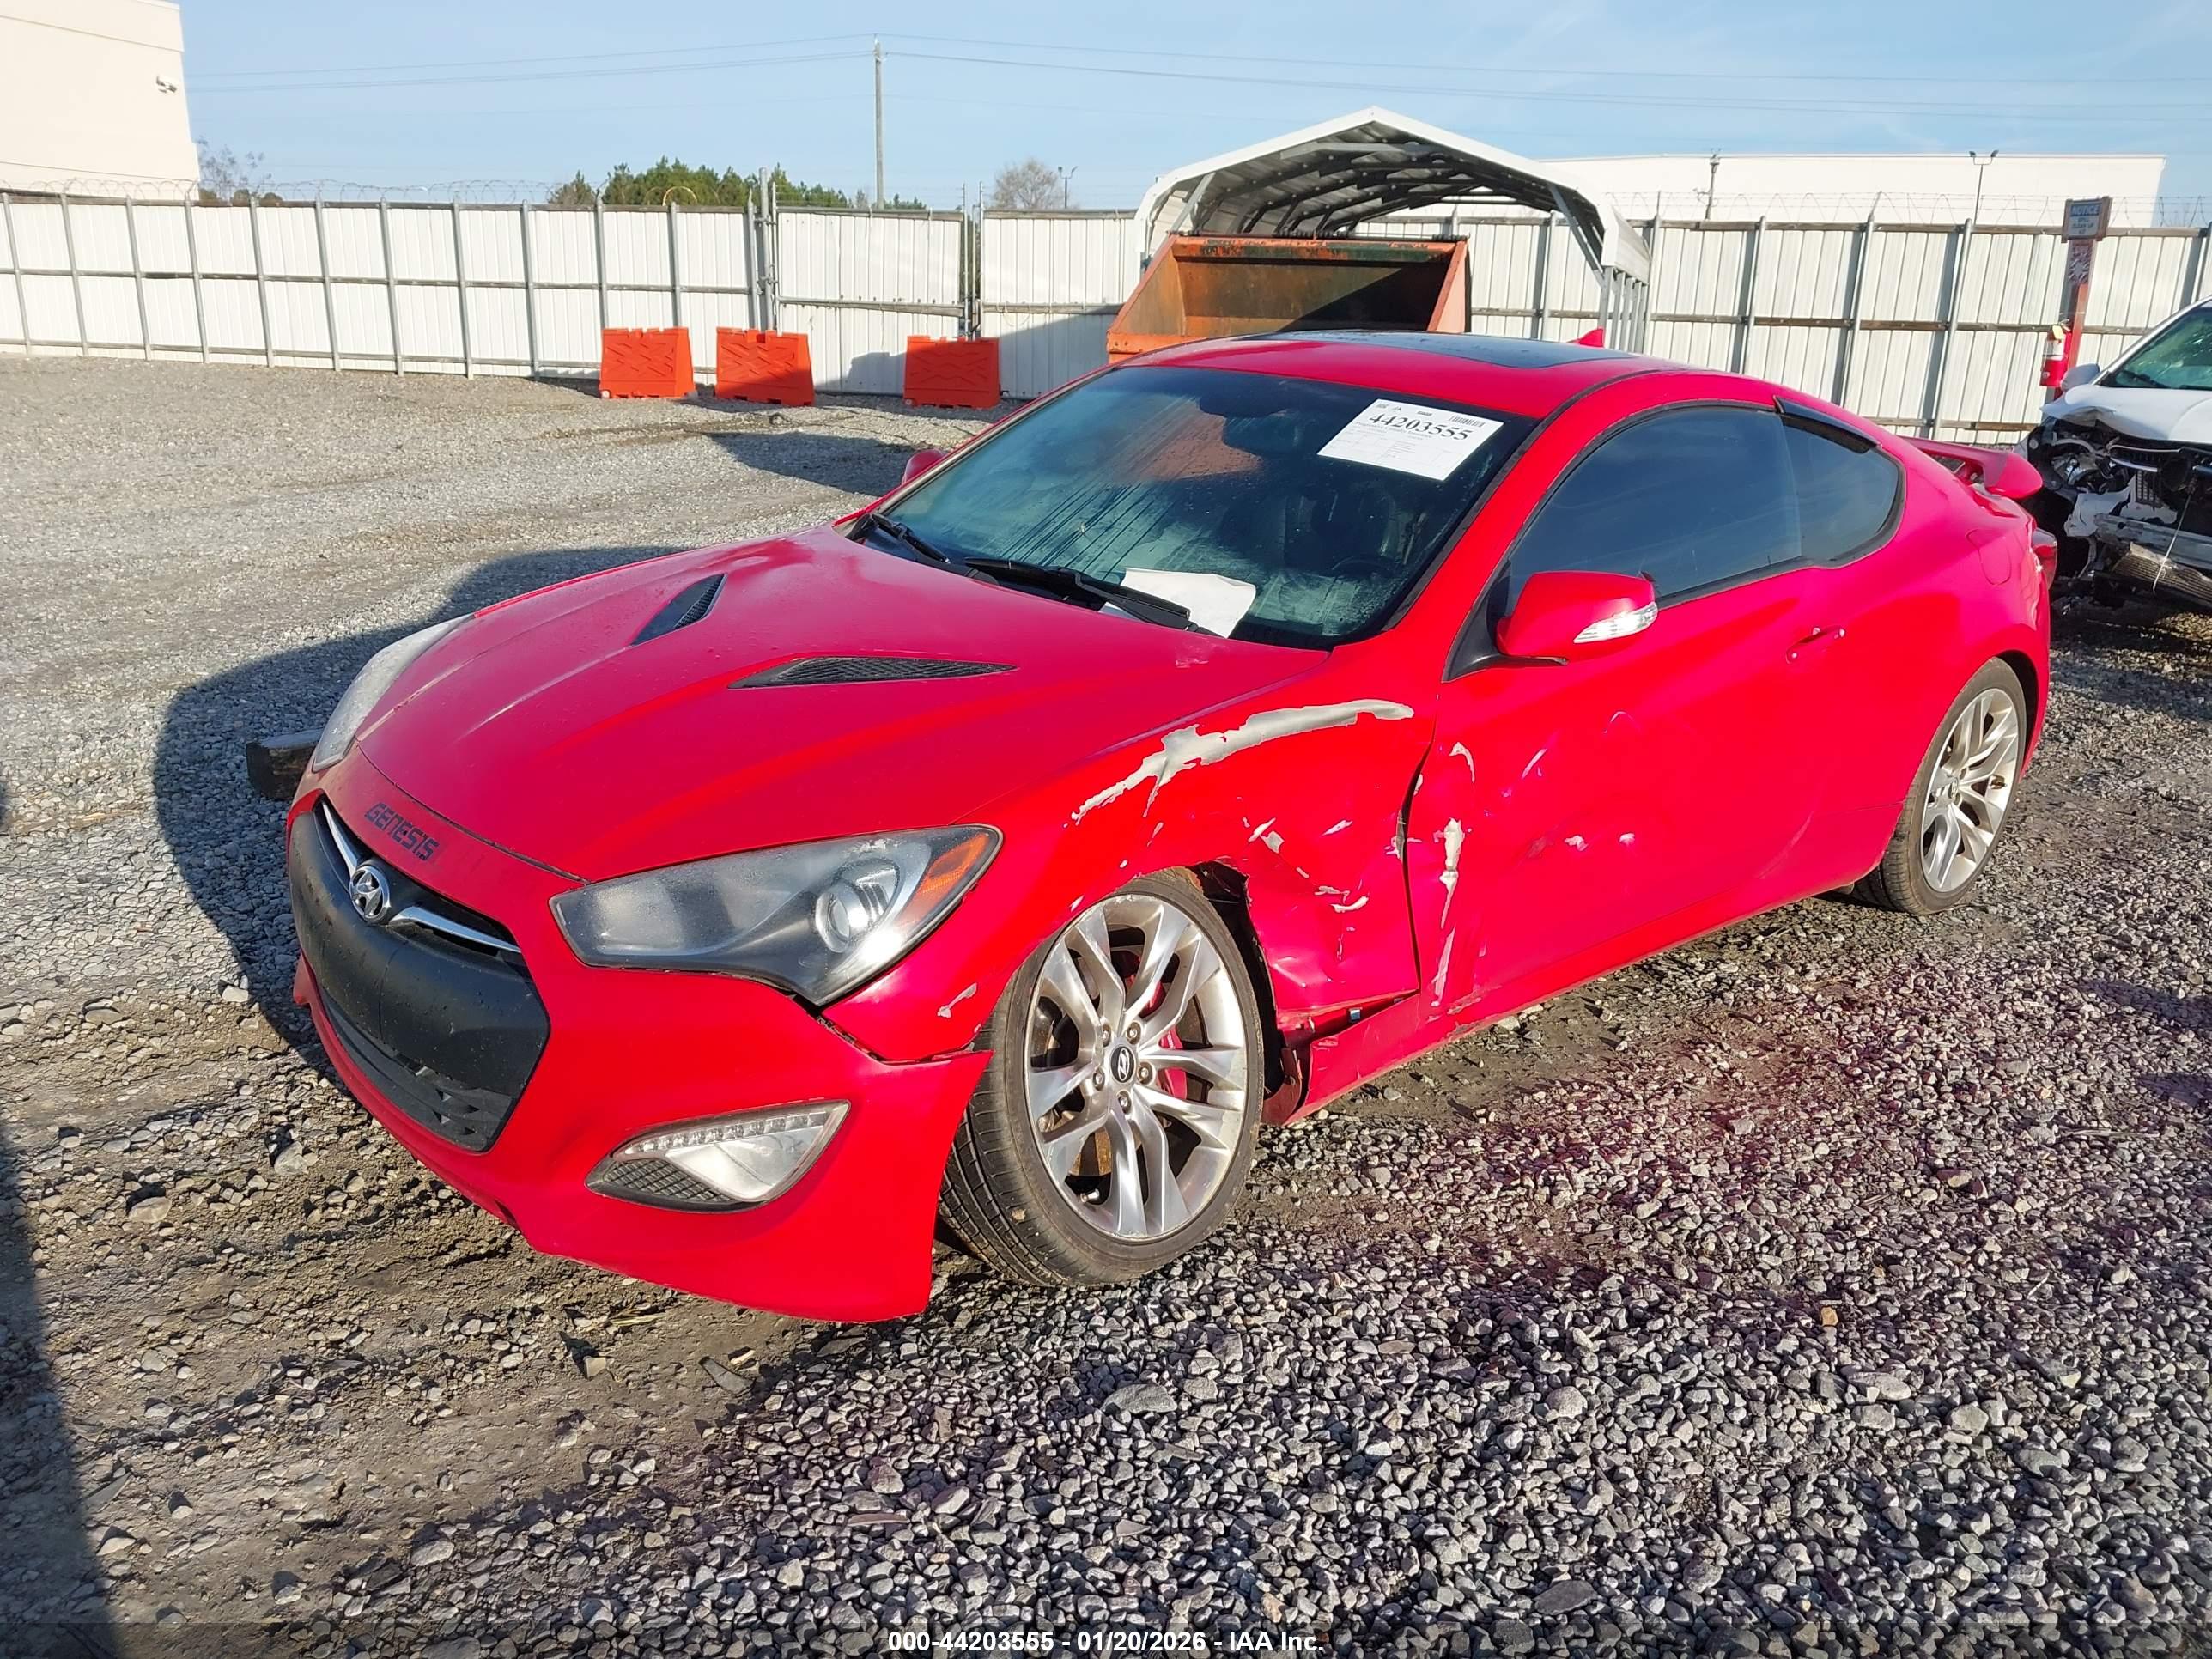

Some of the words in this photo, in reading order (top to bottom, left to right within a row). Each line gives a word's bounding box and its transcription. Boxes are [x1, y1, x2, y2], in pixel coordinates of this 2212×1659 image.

[2072, 205, 2099, 216] NOTICE
[1369, 413, 1474, 441] 44203555
[364, 802, 440, 860] GENESIS
